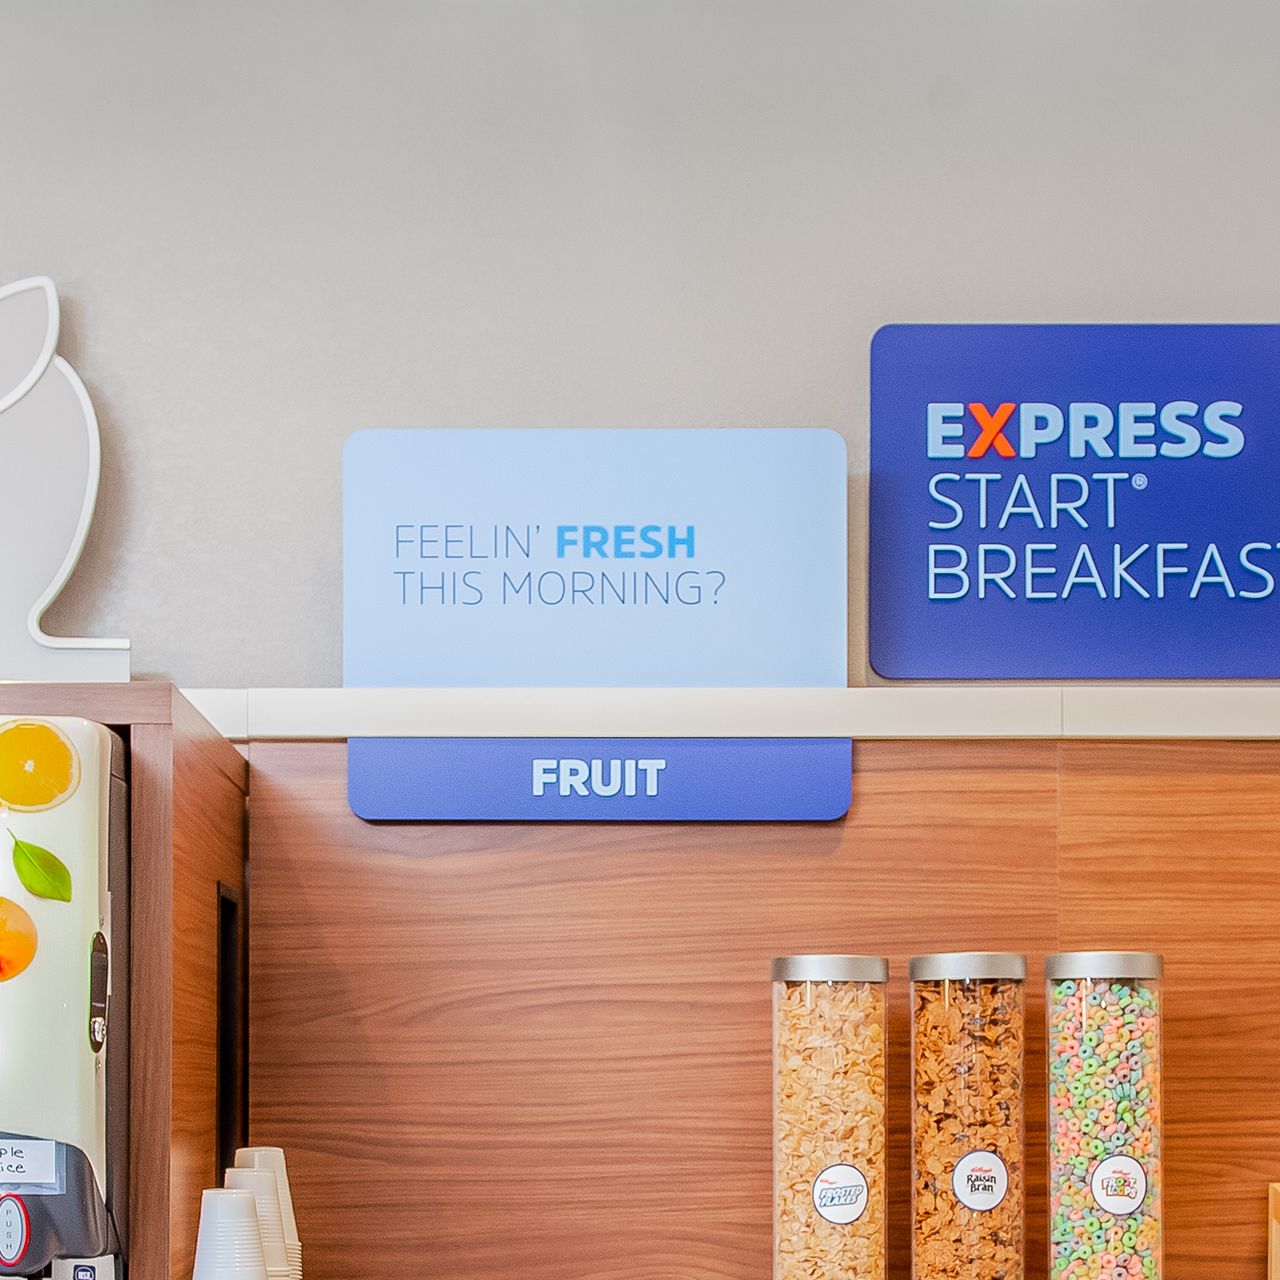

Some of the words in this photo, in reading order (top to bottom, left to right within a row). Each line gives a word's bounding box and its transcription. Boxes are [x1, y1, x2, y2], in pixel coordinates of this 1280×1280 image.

[926, 400, 1246, 460] EXPRESS
[556, 525, 696, 558] FRESH
[393, 570, 483, 605] THIS
[502, 570, 726, 605] MORNING?
[531, 758, 667, 797] FRUIT
[970, 1182, 994, 1193] Bran
[5, 1208, 13, 1250] PUSH
